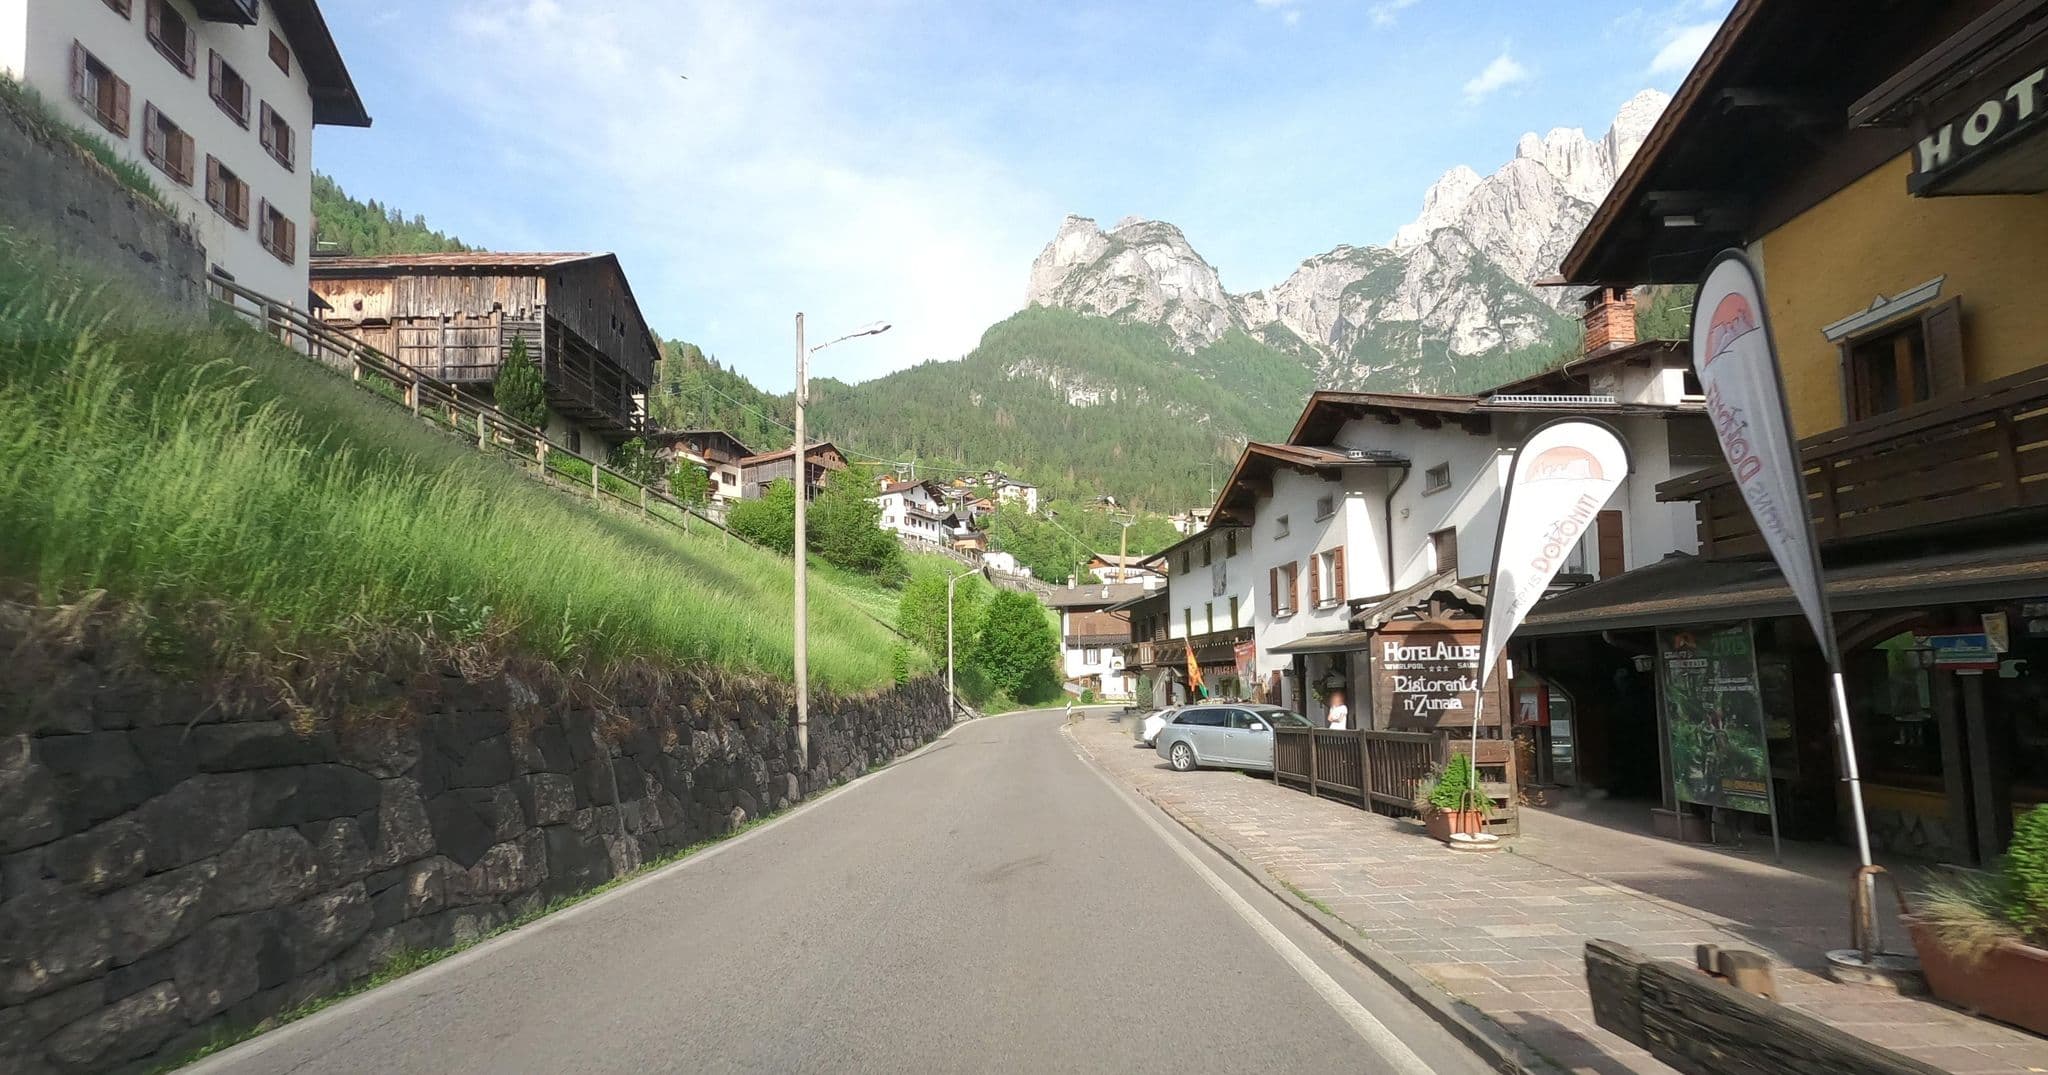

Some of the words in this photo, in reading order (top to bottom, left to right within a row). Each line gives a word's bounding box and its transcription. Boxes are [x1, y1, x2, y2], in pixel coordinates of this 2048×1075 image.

[1919, 68, 2048, 173] HOT
[1531, 493, 1600, 574] DOLOMITI
[1384, 641, 1434, 661] HOTEL
[1435, 641, 1480, 660] ALLEG
